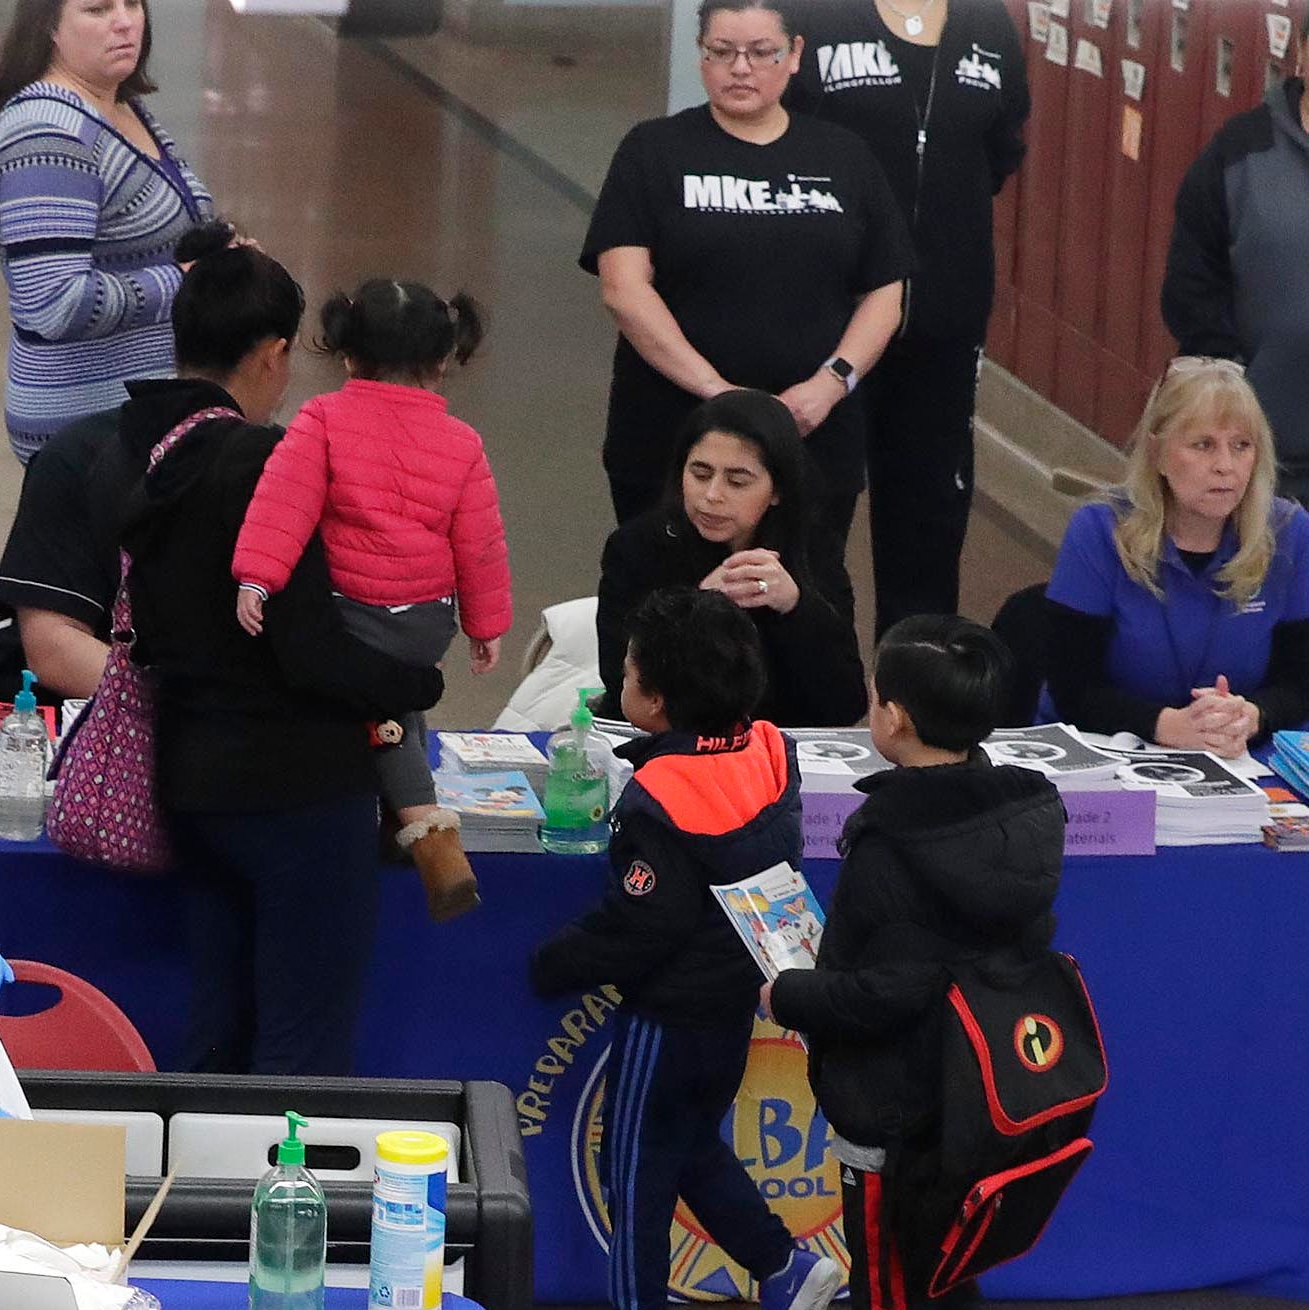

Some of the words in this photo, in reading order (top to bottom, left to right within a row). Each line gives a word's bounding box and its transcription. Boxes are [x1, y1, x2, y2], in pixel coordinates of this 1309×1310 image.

[683, 174, 772, 211] MKE
[1068, 811, 1100, 824] rade
[1066, 831, 1117, 846] aterials
